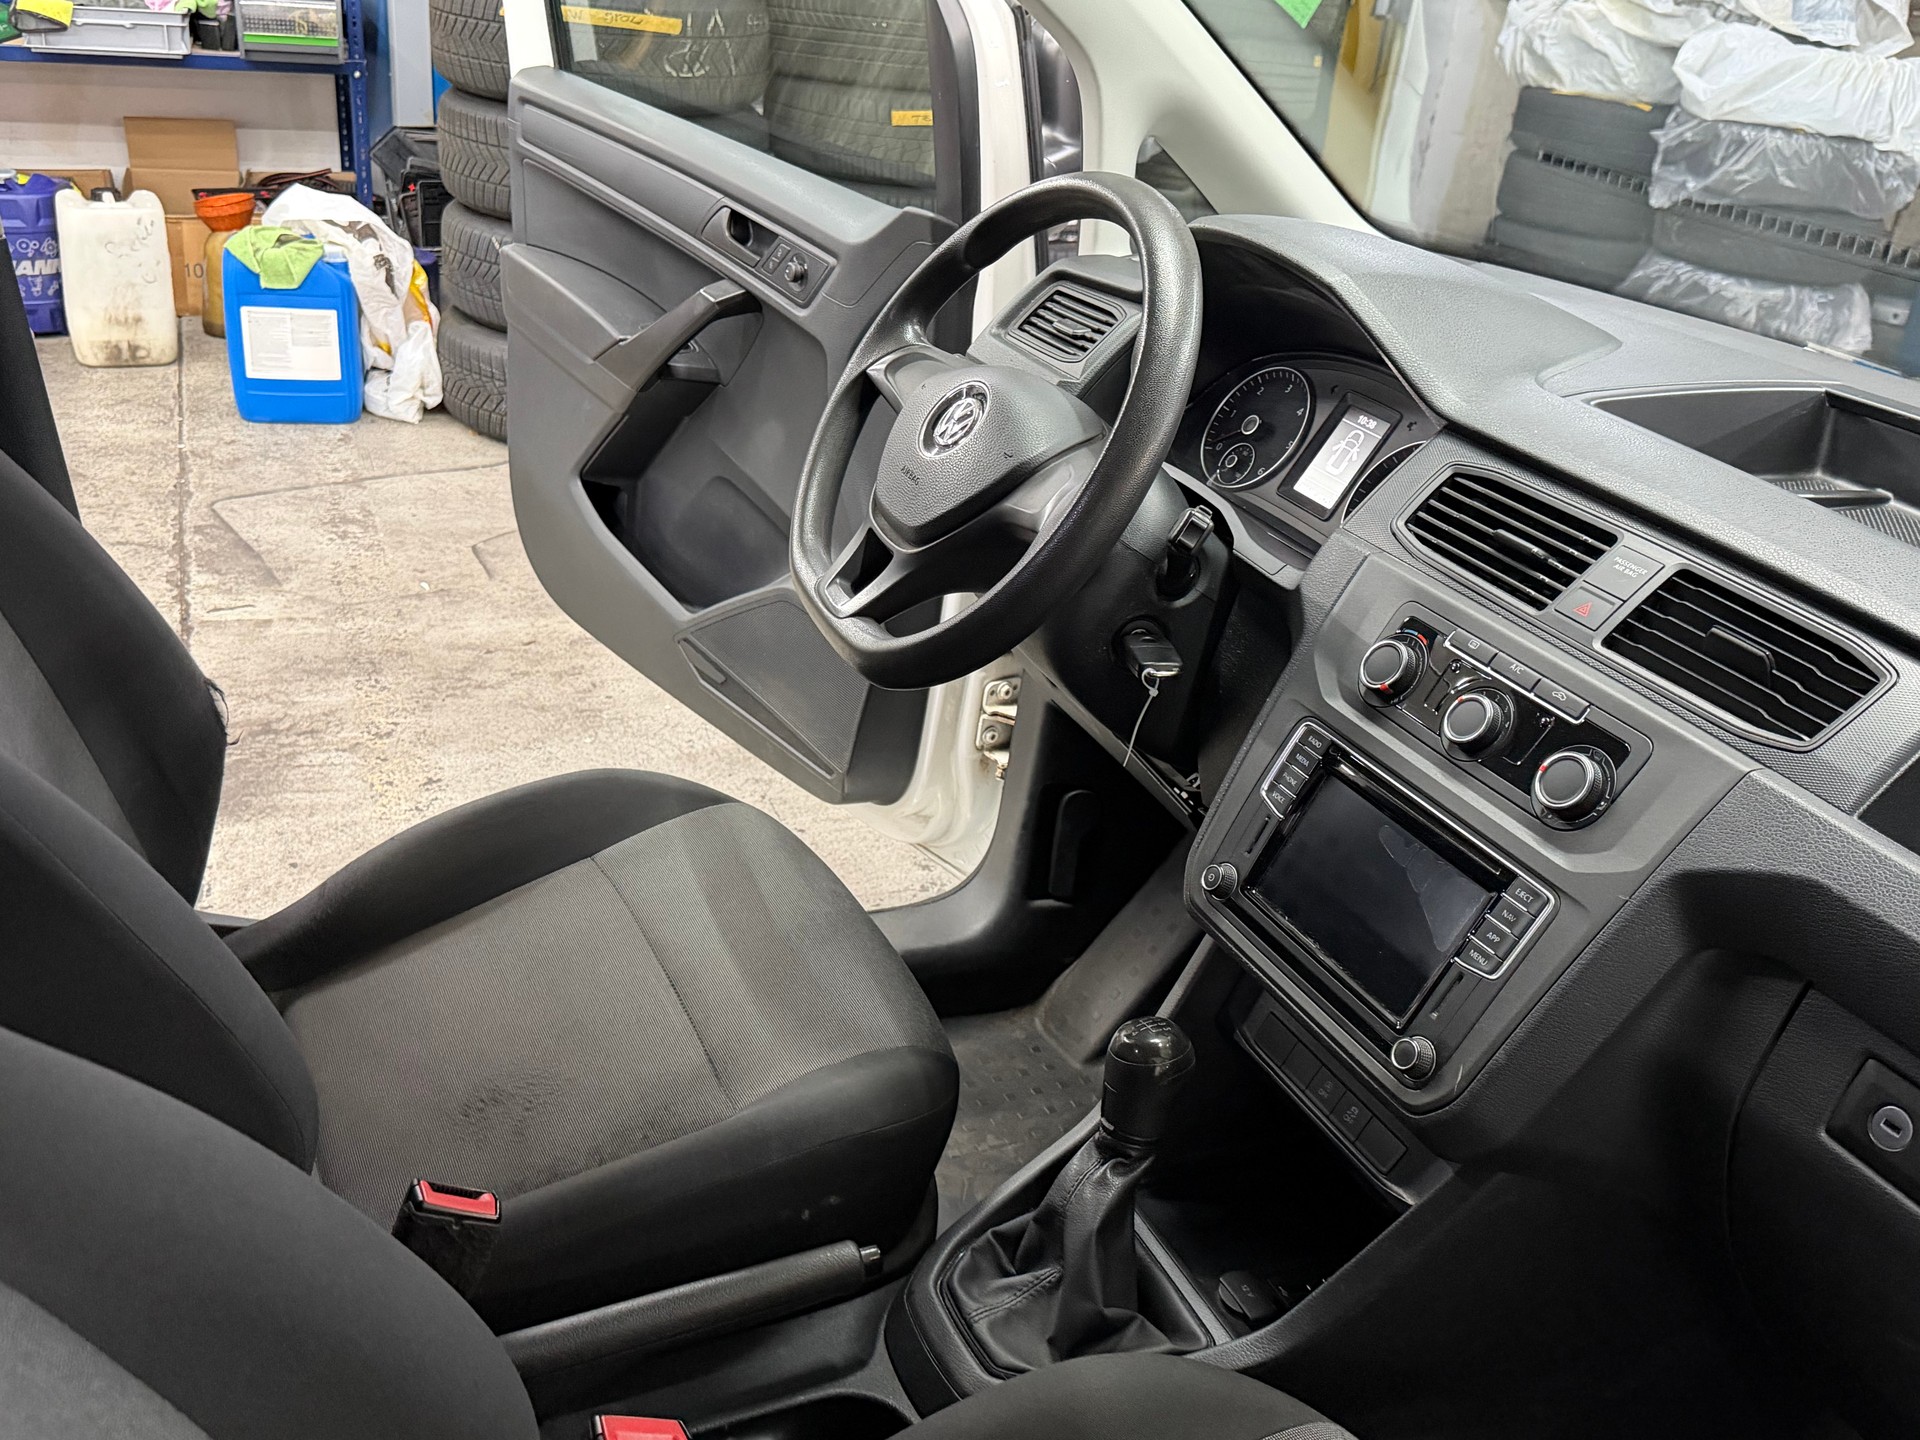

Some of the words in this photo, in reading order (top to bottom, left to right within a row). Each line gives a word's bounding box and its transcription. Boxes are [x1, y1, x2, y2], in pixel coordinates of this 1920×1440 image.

[1256, 387, 1265, 395] 2
[1284, 384, 1293, 393] 3
[1357, 415, 1378, 430] 10:38
[900, 465, 920, 487] AIRBAG
[1257, 467, 1266, 475] 6
[1623, 568, 1639, 578] BAG
[1508, 663, 1525, 675] A/C
[1308, 735, 1322, 748] RADIO
[1295, 753, 1310, 767] MEDIA
[1272, 790, 1285, 804] VOICE
[1515, 888, 1534, 903] EJECT
[1501, 909, 1517, 922] NAV
[1486, 931, 1501, 943] APP
[1468, 949, 1488, 966] MENU
